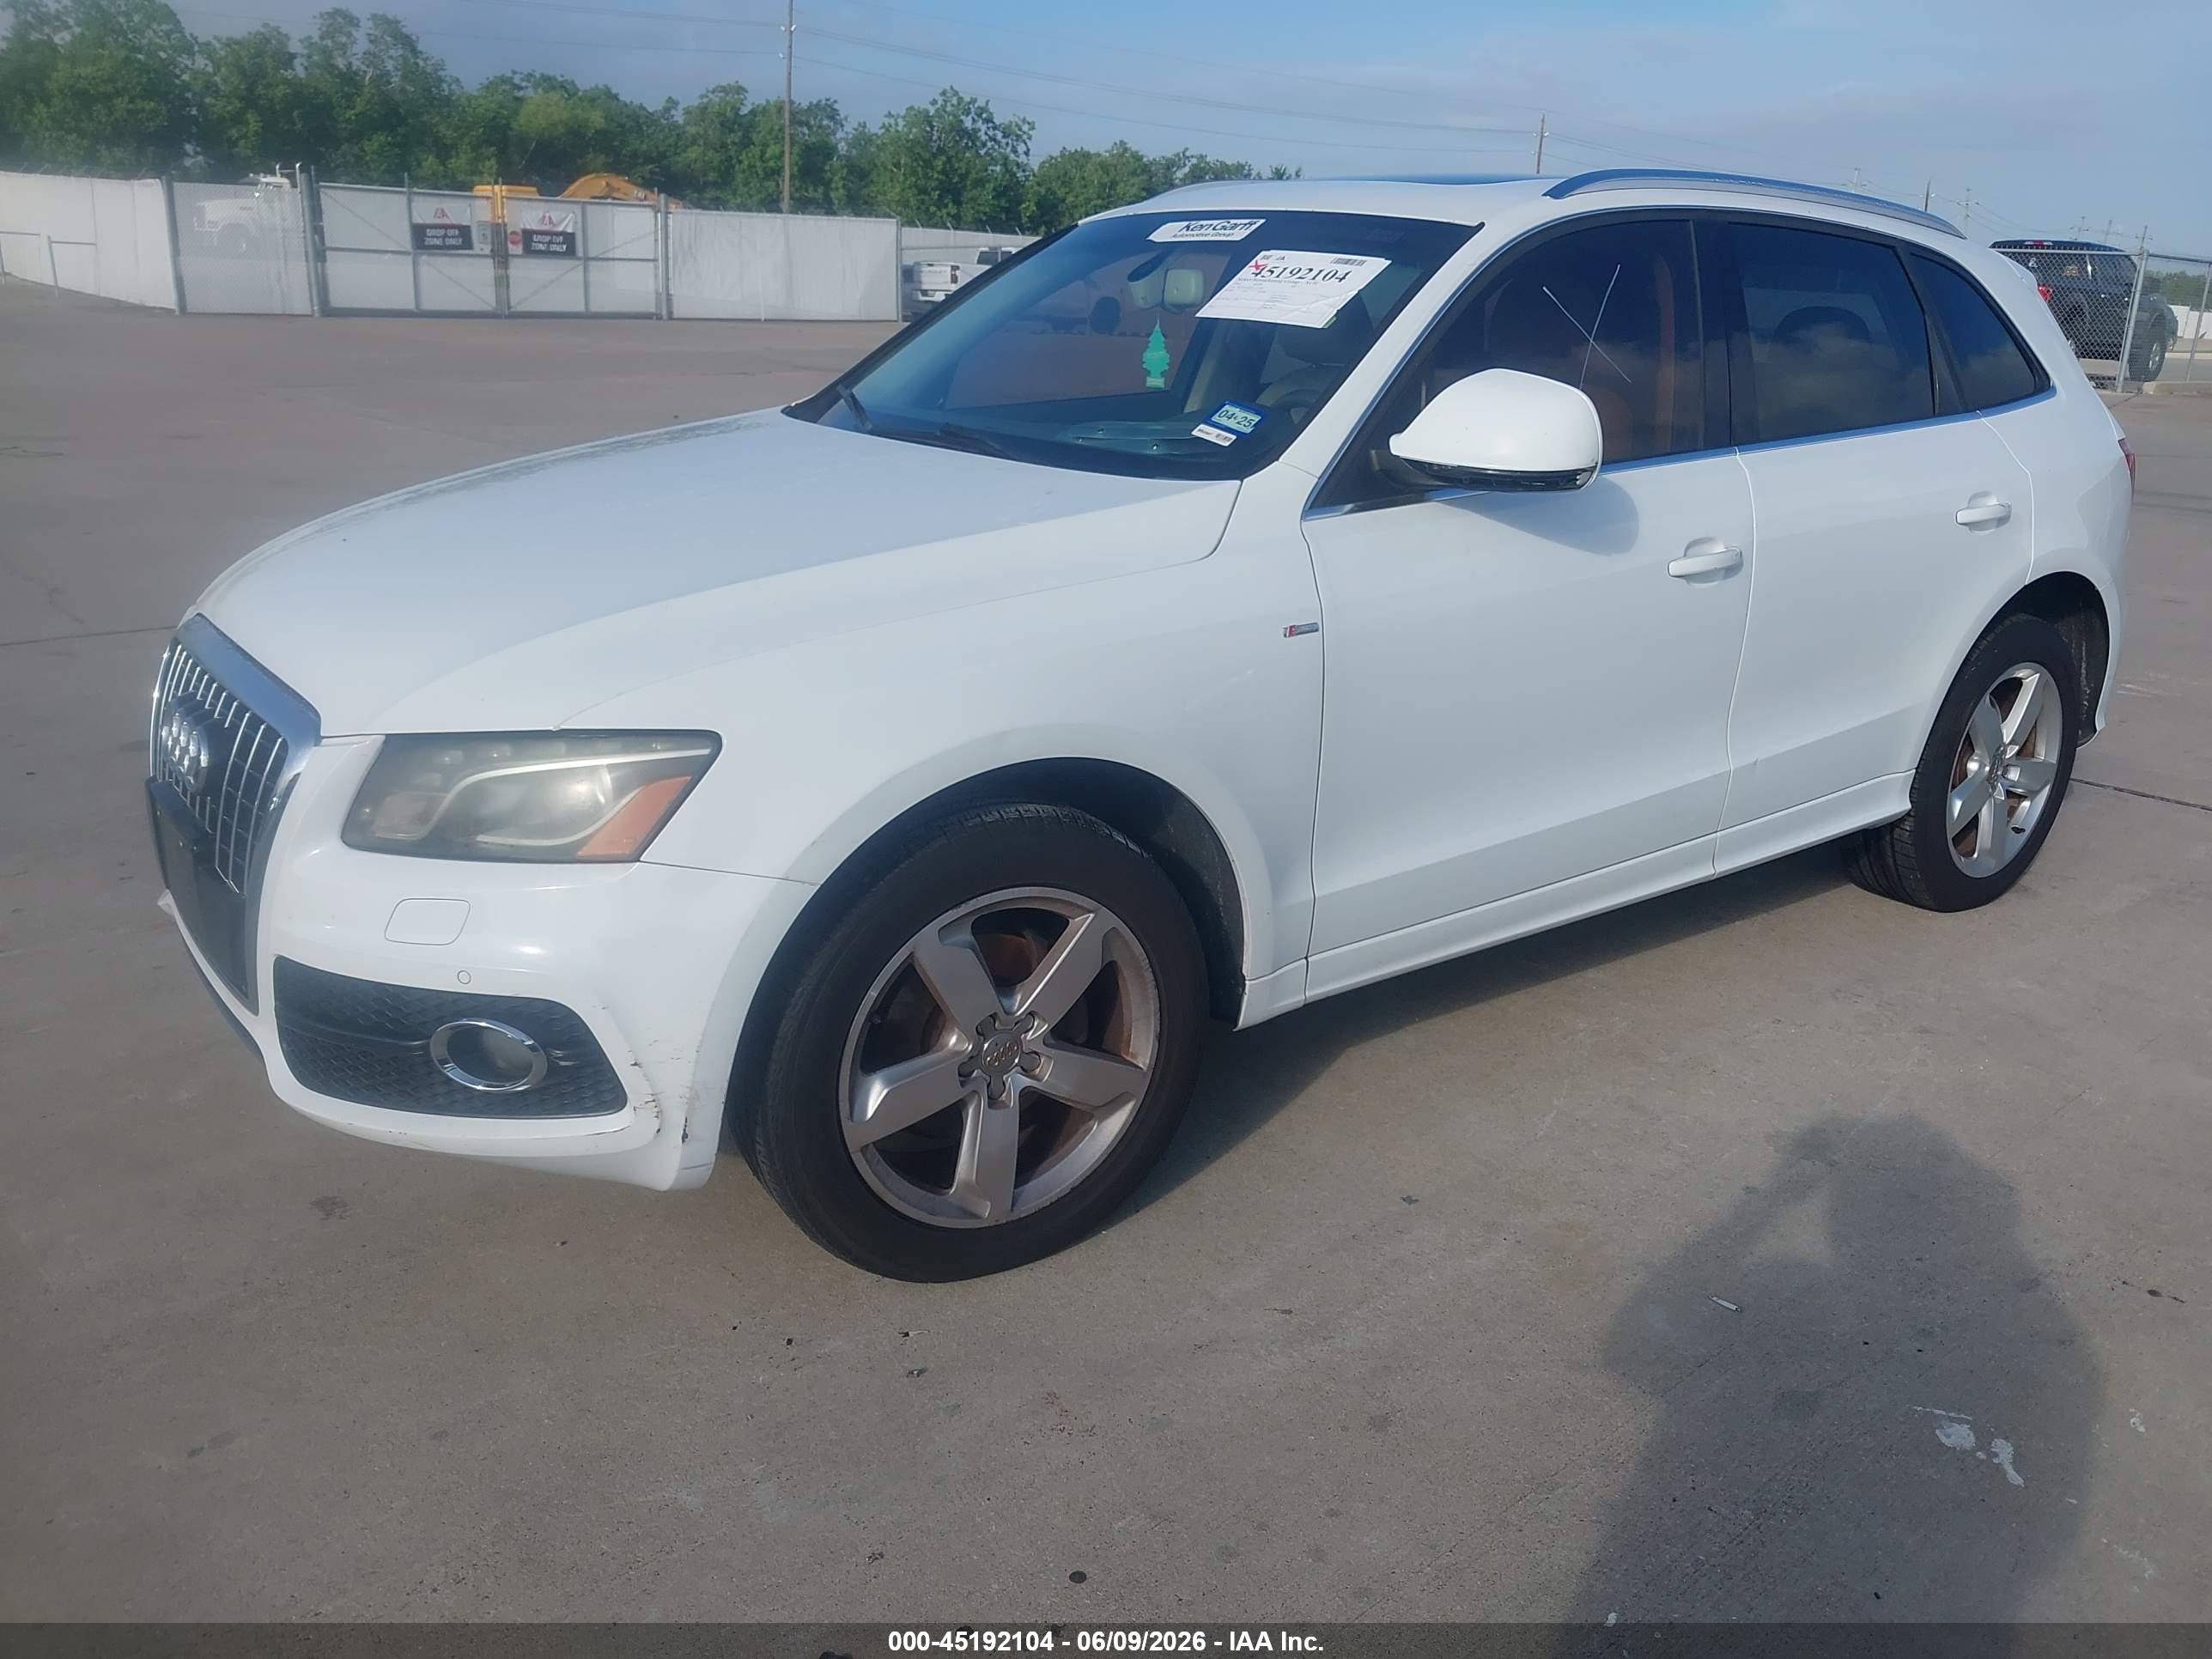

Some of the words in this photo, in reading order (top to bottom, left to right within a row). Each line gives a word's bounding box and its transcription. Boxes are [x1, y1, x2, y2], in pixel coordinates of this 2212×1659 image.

[1178, 222, 1211, 233] Ken
[1212, 220, 1261, 232] Garff
[1251, 265, 1352, 283] 45192104
